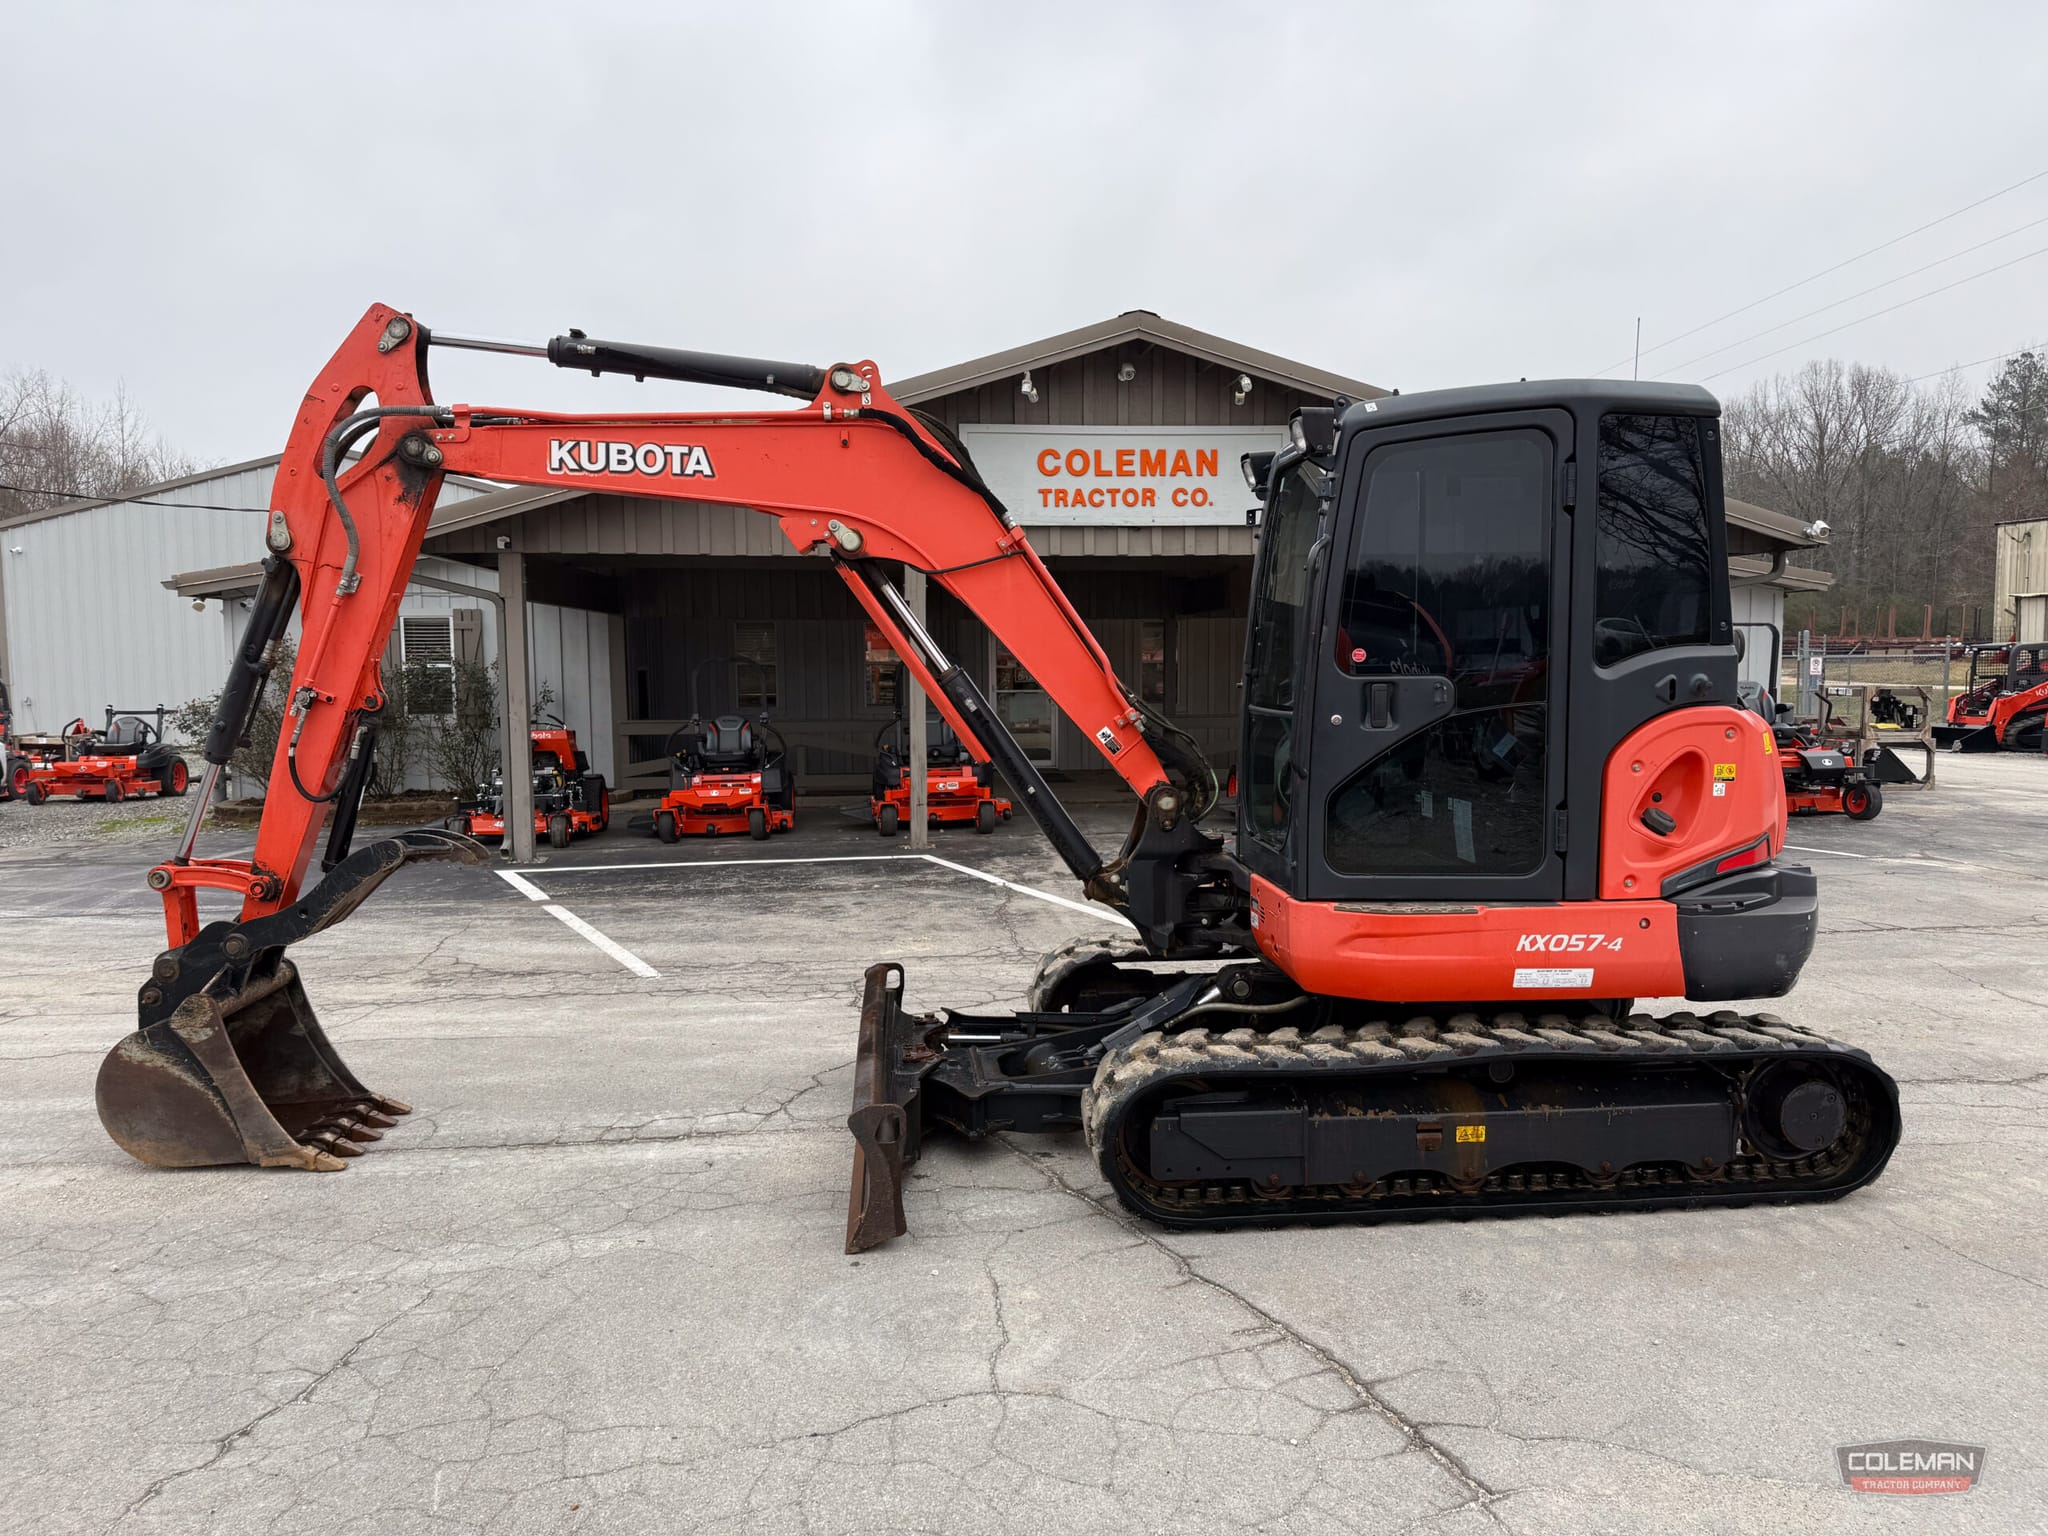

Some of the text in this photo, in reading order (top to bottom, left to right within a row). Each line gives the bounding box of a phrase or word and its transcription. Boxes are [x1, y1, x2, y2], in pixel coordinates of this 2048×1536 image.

[549, 439, 715, 477] KUBOTA
[1037, 448, 1219, 477] COLEMAN
[1038, 487, 1214, 507] TRACTOR CO.
[1516, 934, 1624, 952] KX057-4
